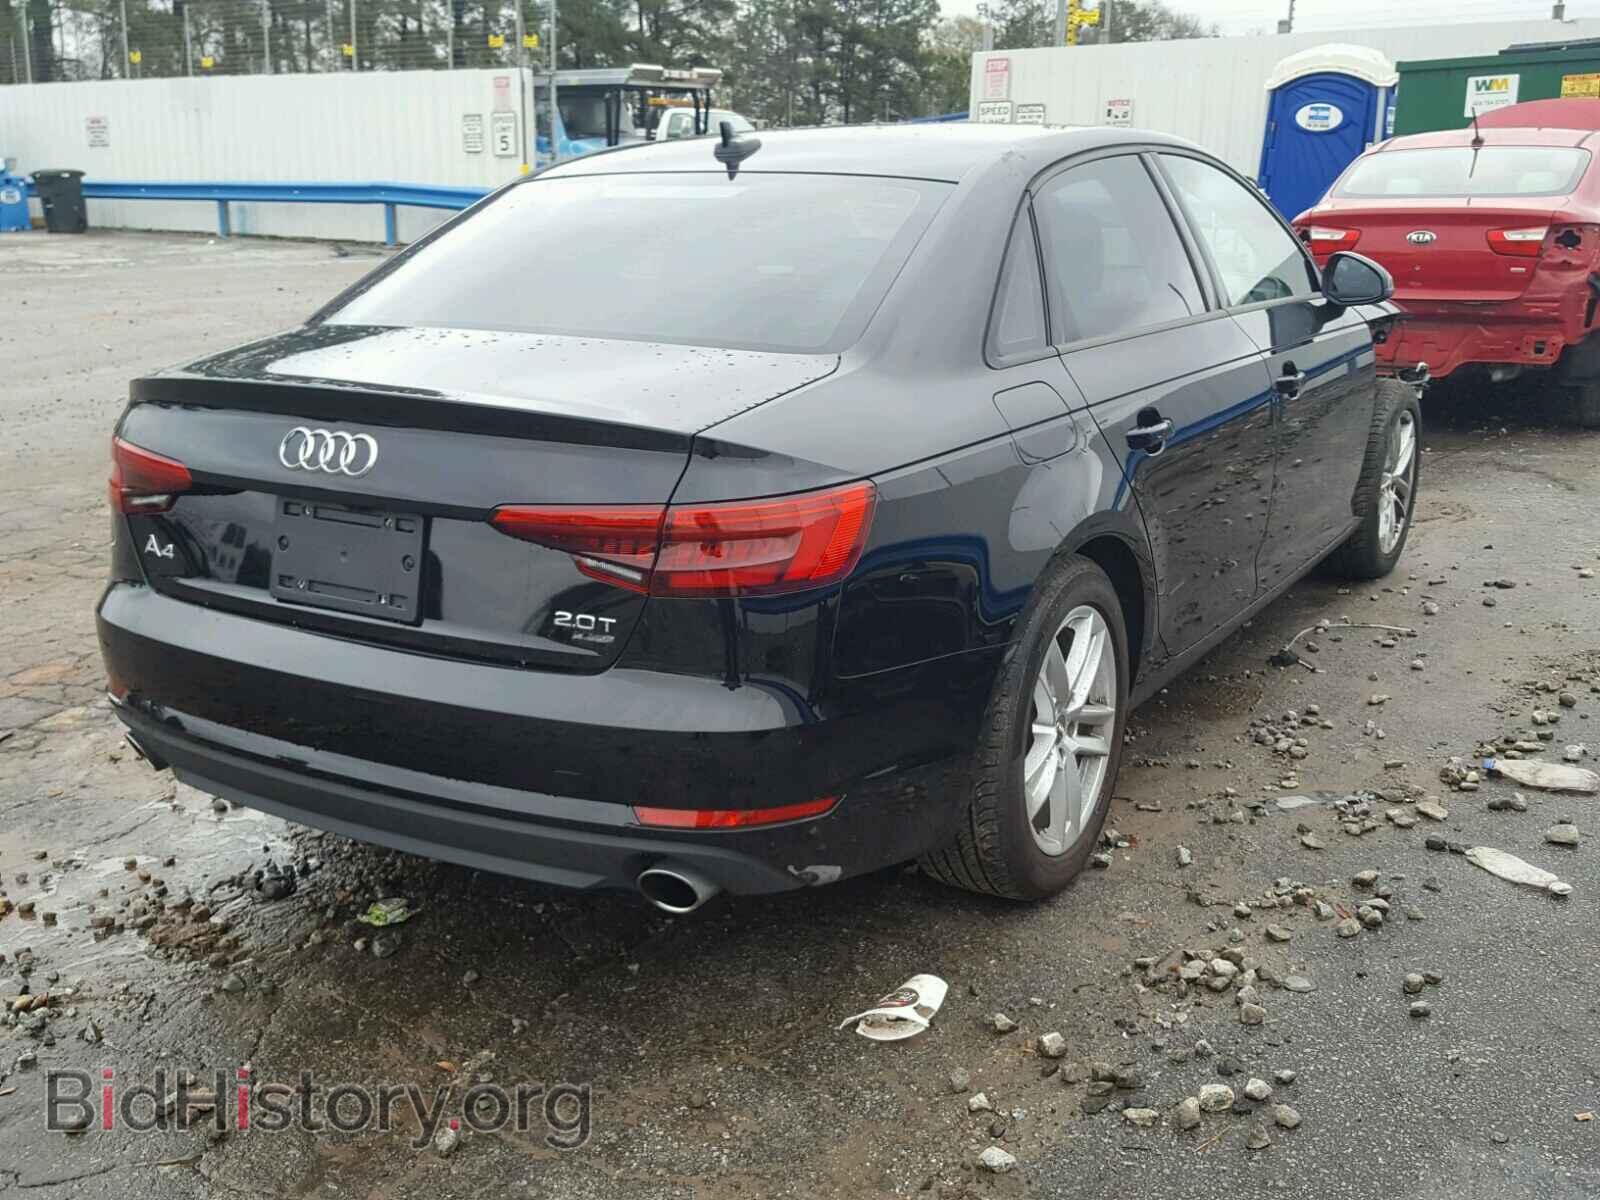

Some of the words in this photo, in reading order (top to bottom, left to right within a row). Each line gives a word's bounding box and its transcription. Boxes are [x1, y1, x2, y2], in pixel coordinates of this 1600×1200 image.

[1475, 79, 1509, 91] WM
[980, 106, 1009, 115] SPEED
[500, 135, 510, 152] 5
[144, 533, 175, 560] A4
[553, 610, 617, 633] 2.0T
